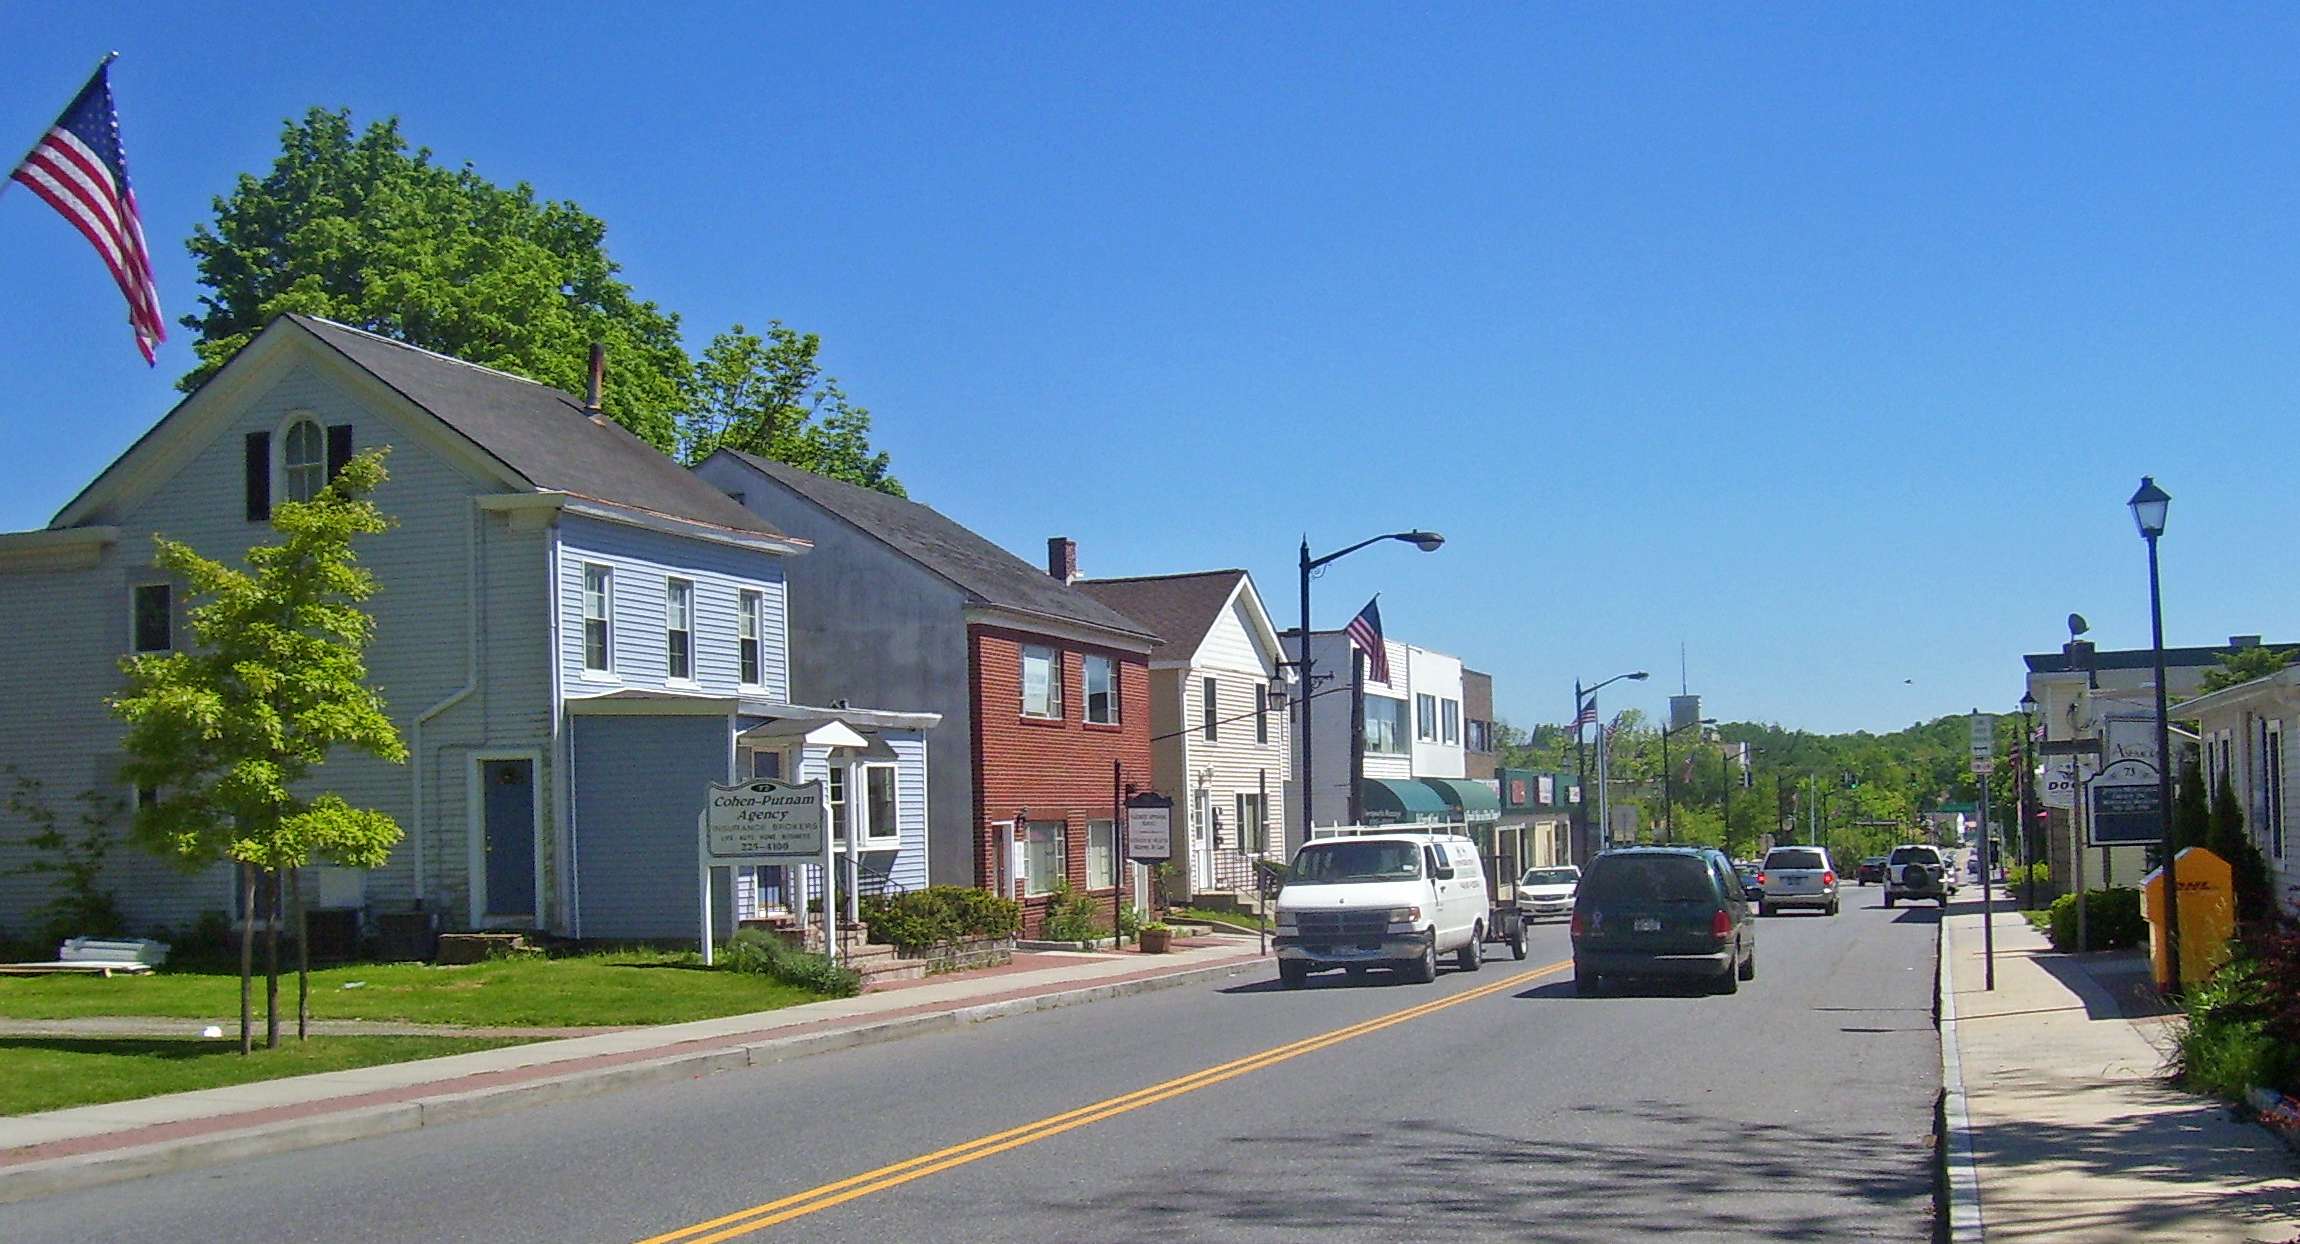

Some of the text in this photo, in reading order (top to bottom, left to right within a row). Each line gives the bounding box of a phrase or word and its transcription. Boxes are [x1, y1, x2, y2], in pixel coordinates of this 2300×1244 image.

[714, 795, 814, 807] Cohen-Putnam
[736, 810, 789, 822] Agency
[772, 822, 818, 831] BROKERS
